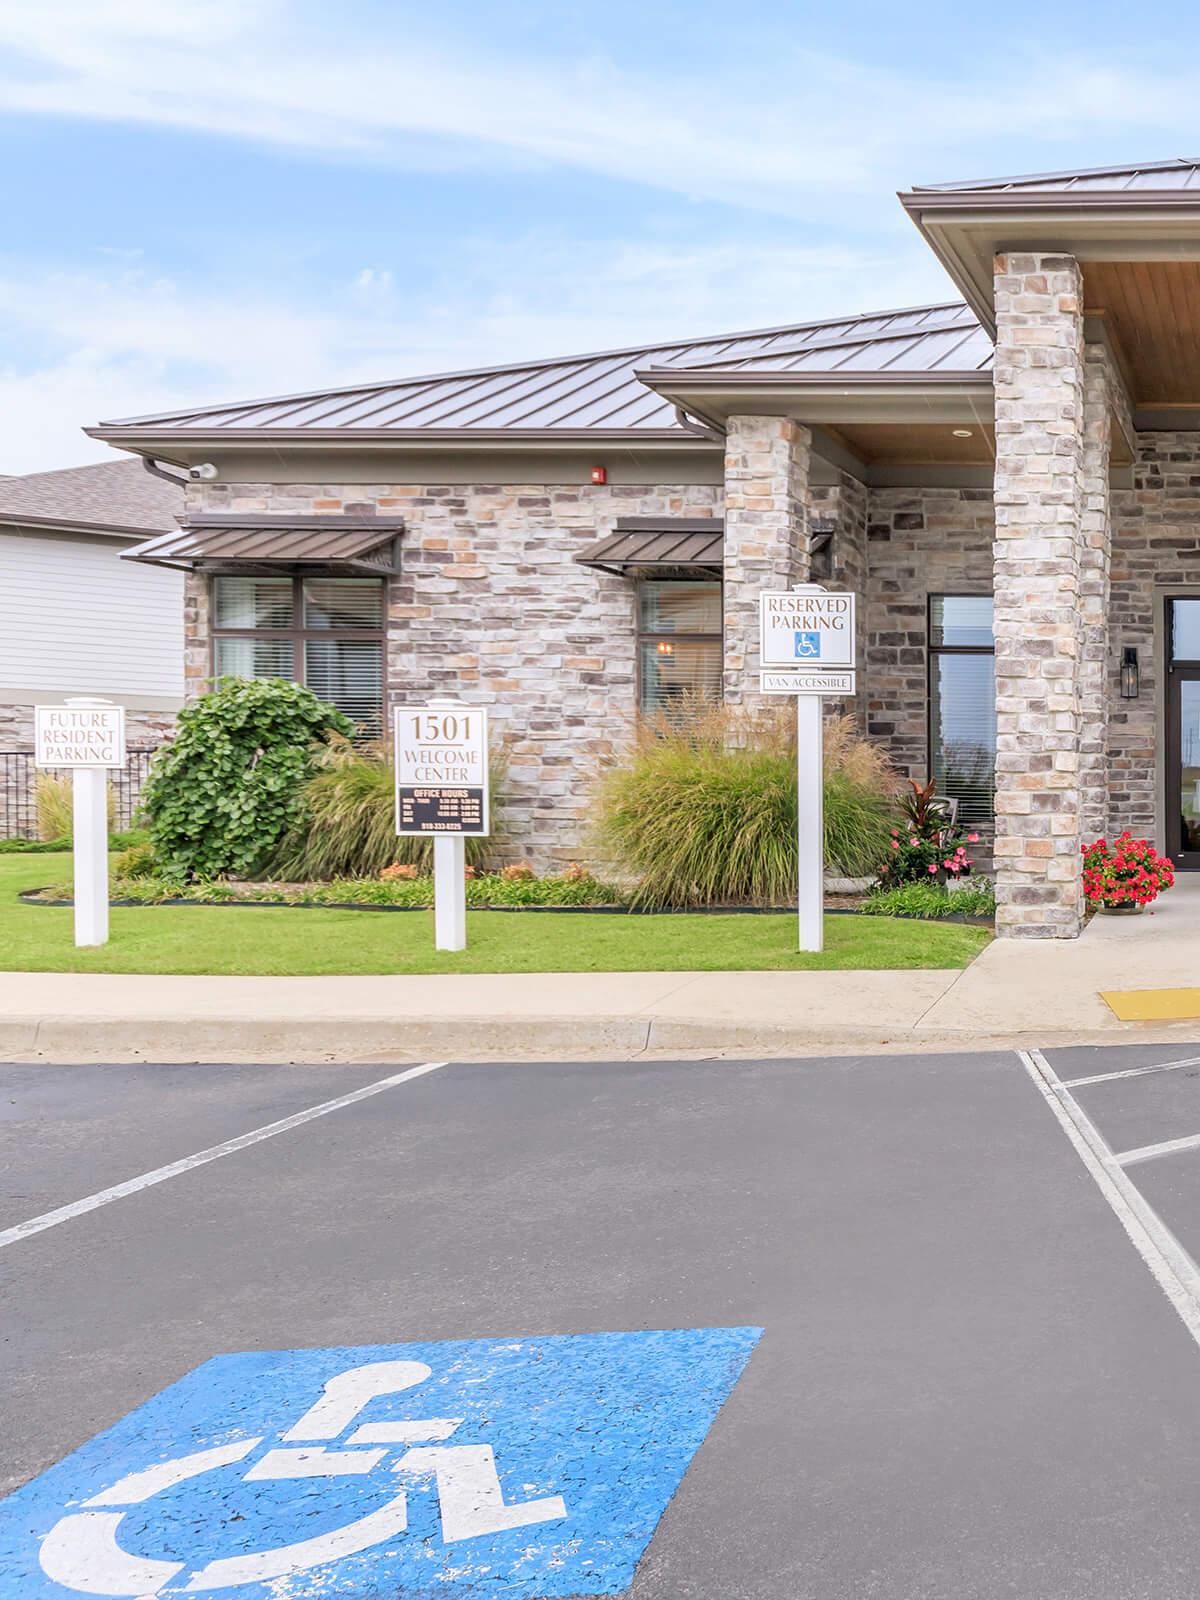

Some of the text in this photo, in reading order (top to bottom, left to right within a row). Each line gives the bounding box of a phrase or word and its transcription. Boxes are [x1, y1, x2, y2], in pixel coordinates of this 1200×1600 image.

[768, 598, 848, 613] RESERVED
[772, 615, 844, 630] PARKING
[768, 678, 847, 688] VAN ACCESSIBLE
[50, 713, 109, 727] FUTURE
[410, 715, 470, 741] 1501
[43, 729, 115, 744] RESIDENT
[46, 746, 113, 761] PARKING
[404, 749, 480, 764] WELCOME
[414, 767, 469, 781] CENTER
[413, 789, 440, 798] OFFICE
